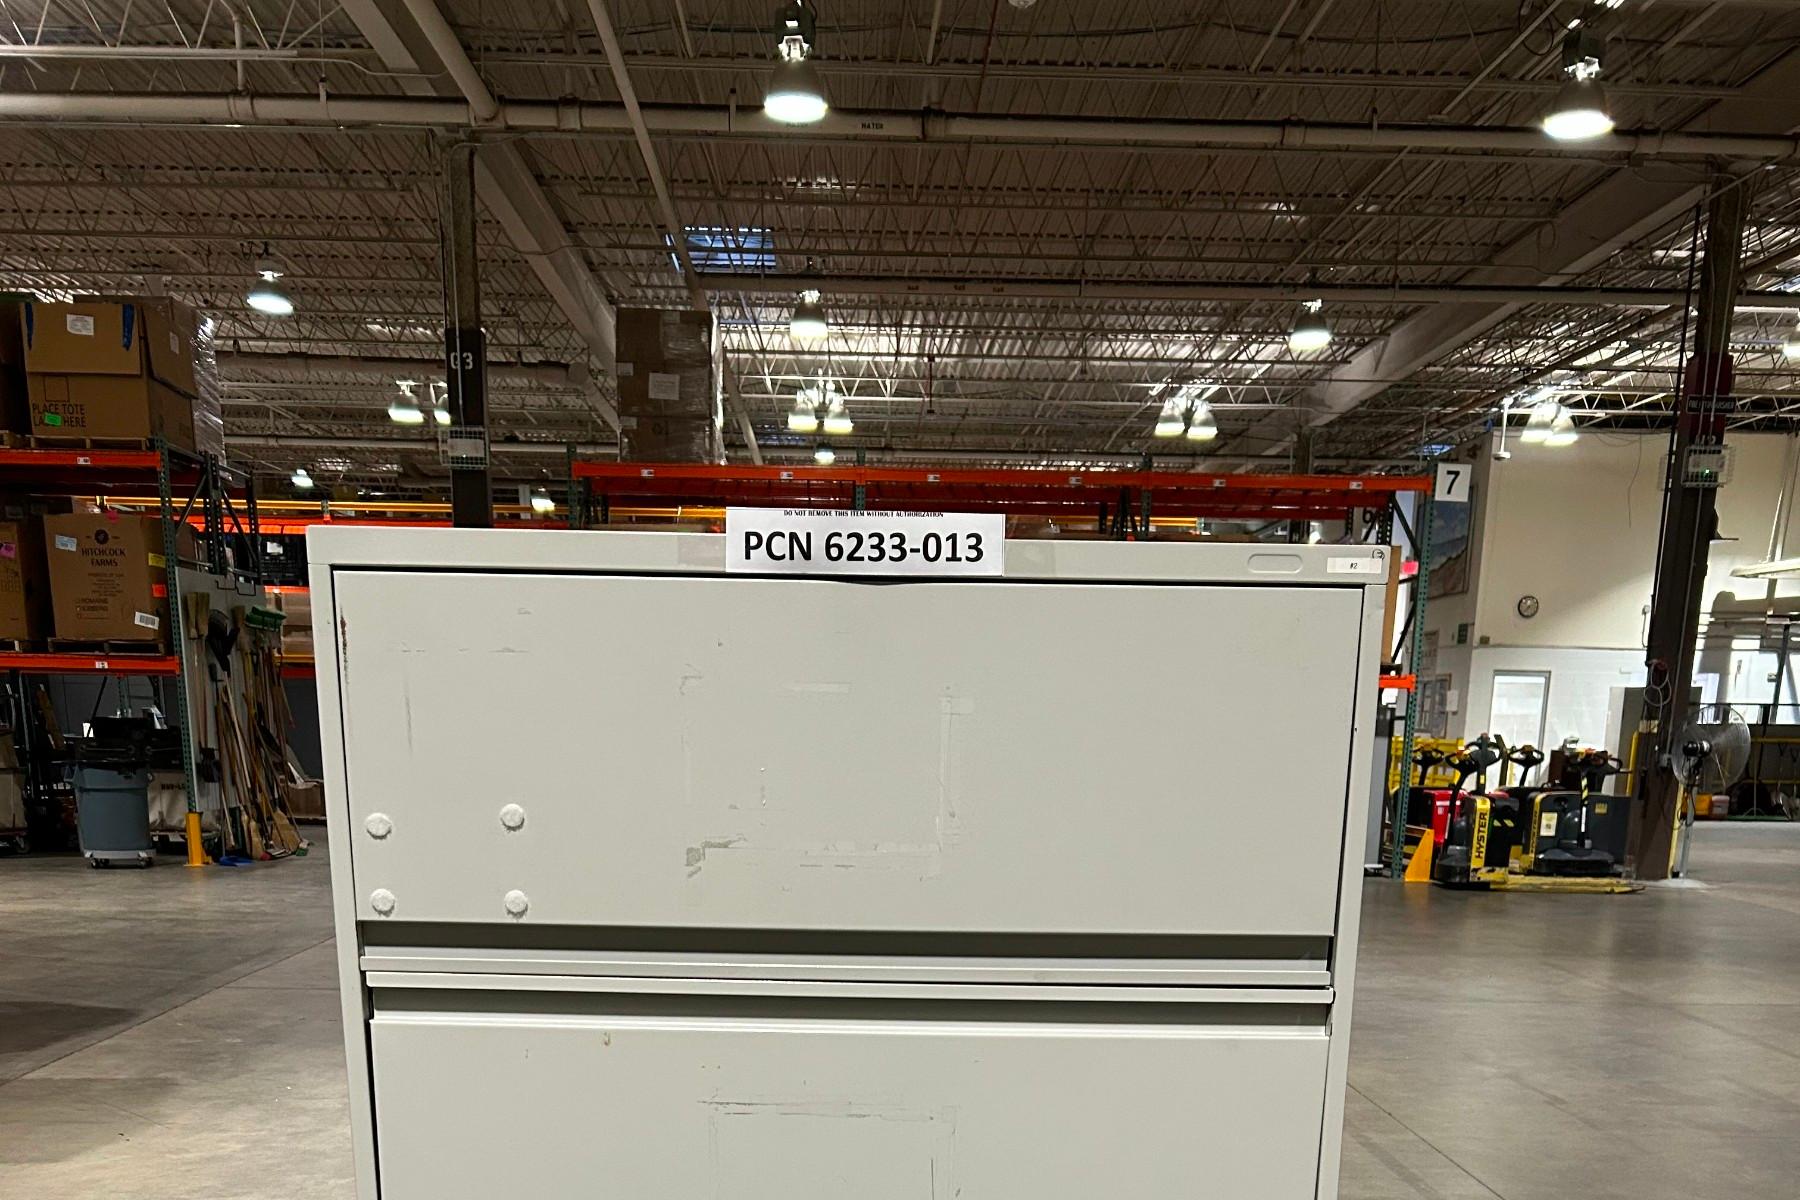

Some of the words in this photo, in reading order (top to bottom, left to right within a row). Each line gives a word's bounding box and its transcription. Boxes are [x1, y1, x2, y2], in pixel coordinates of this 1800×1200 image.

[32, 403, 60, 415] PLACE
[62, 404, 85, 415] TOTE
[64, 416, 87, 428] HERE
[1446, 470, 1461, 495] 7
[783, 509, 793, 517] DO
[794, 509, 806, 517] NOT
[81, 547, 126, 557] HITCHCOCK
[743, 530, 812, 561] PCN
[824, 531, 984, 563] 6233-013
[91, 559, 118, 567] FARMS
[1475, 811, 1488, 859] HYSTER
